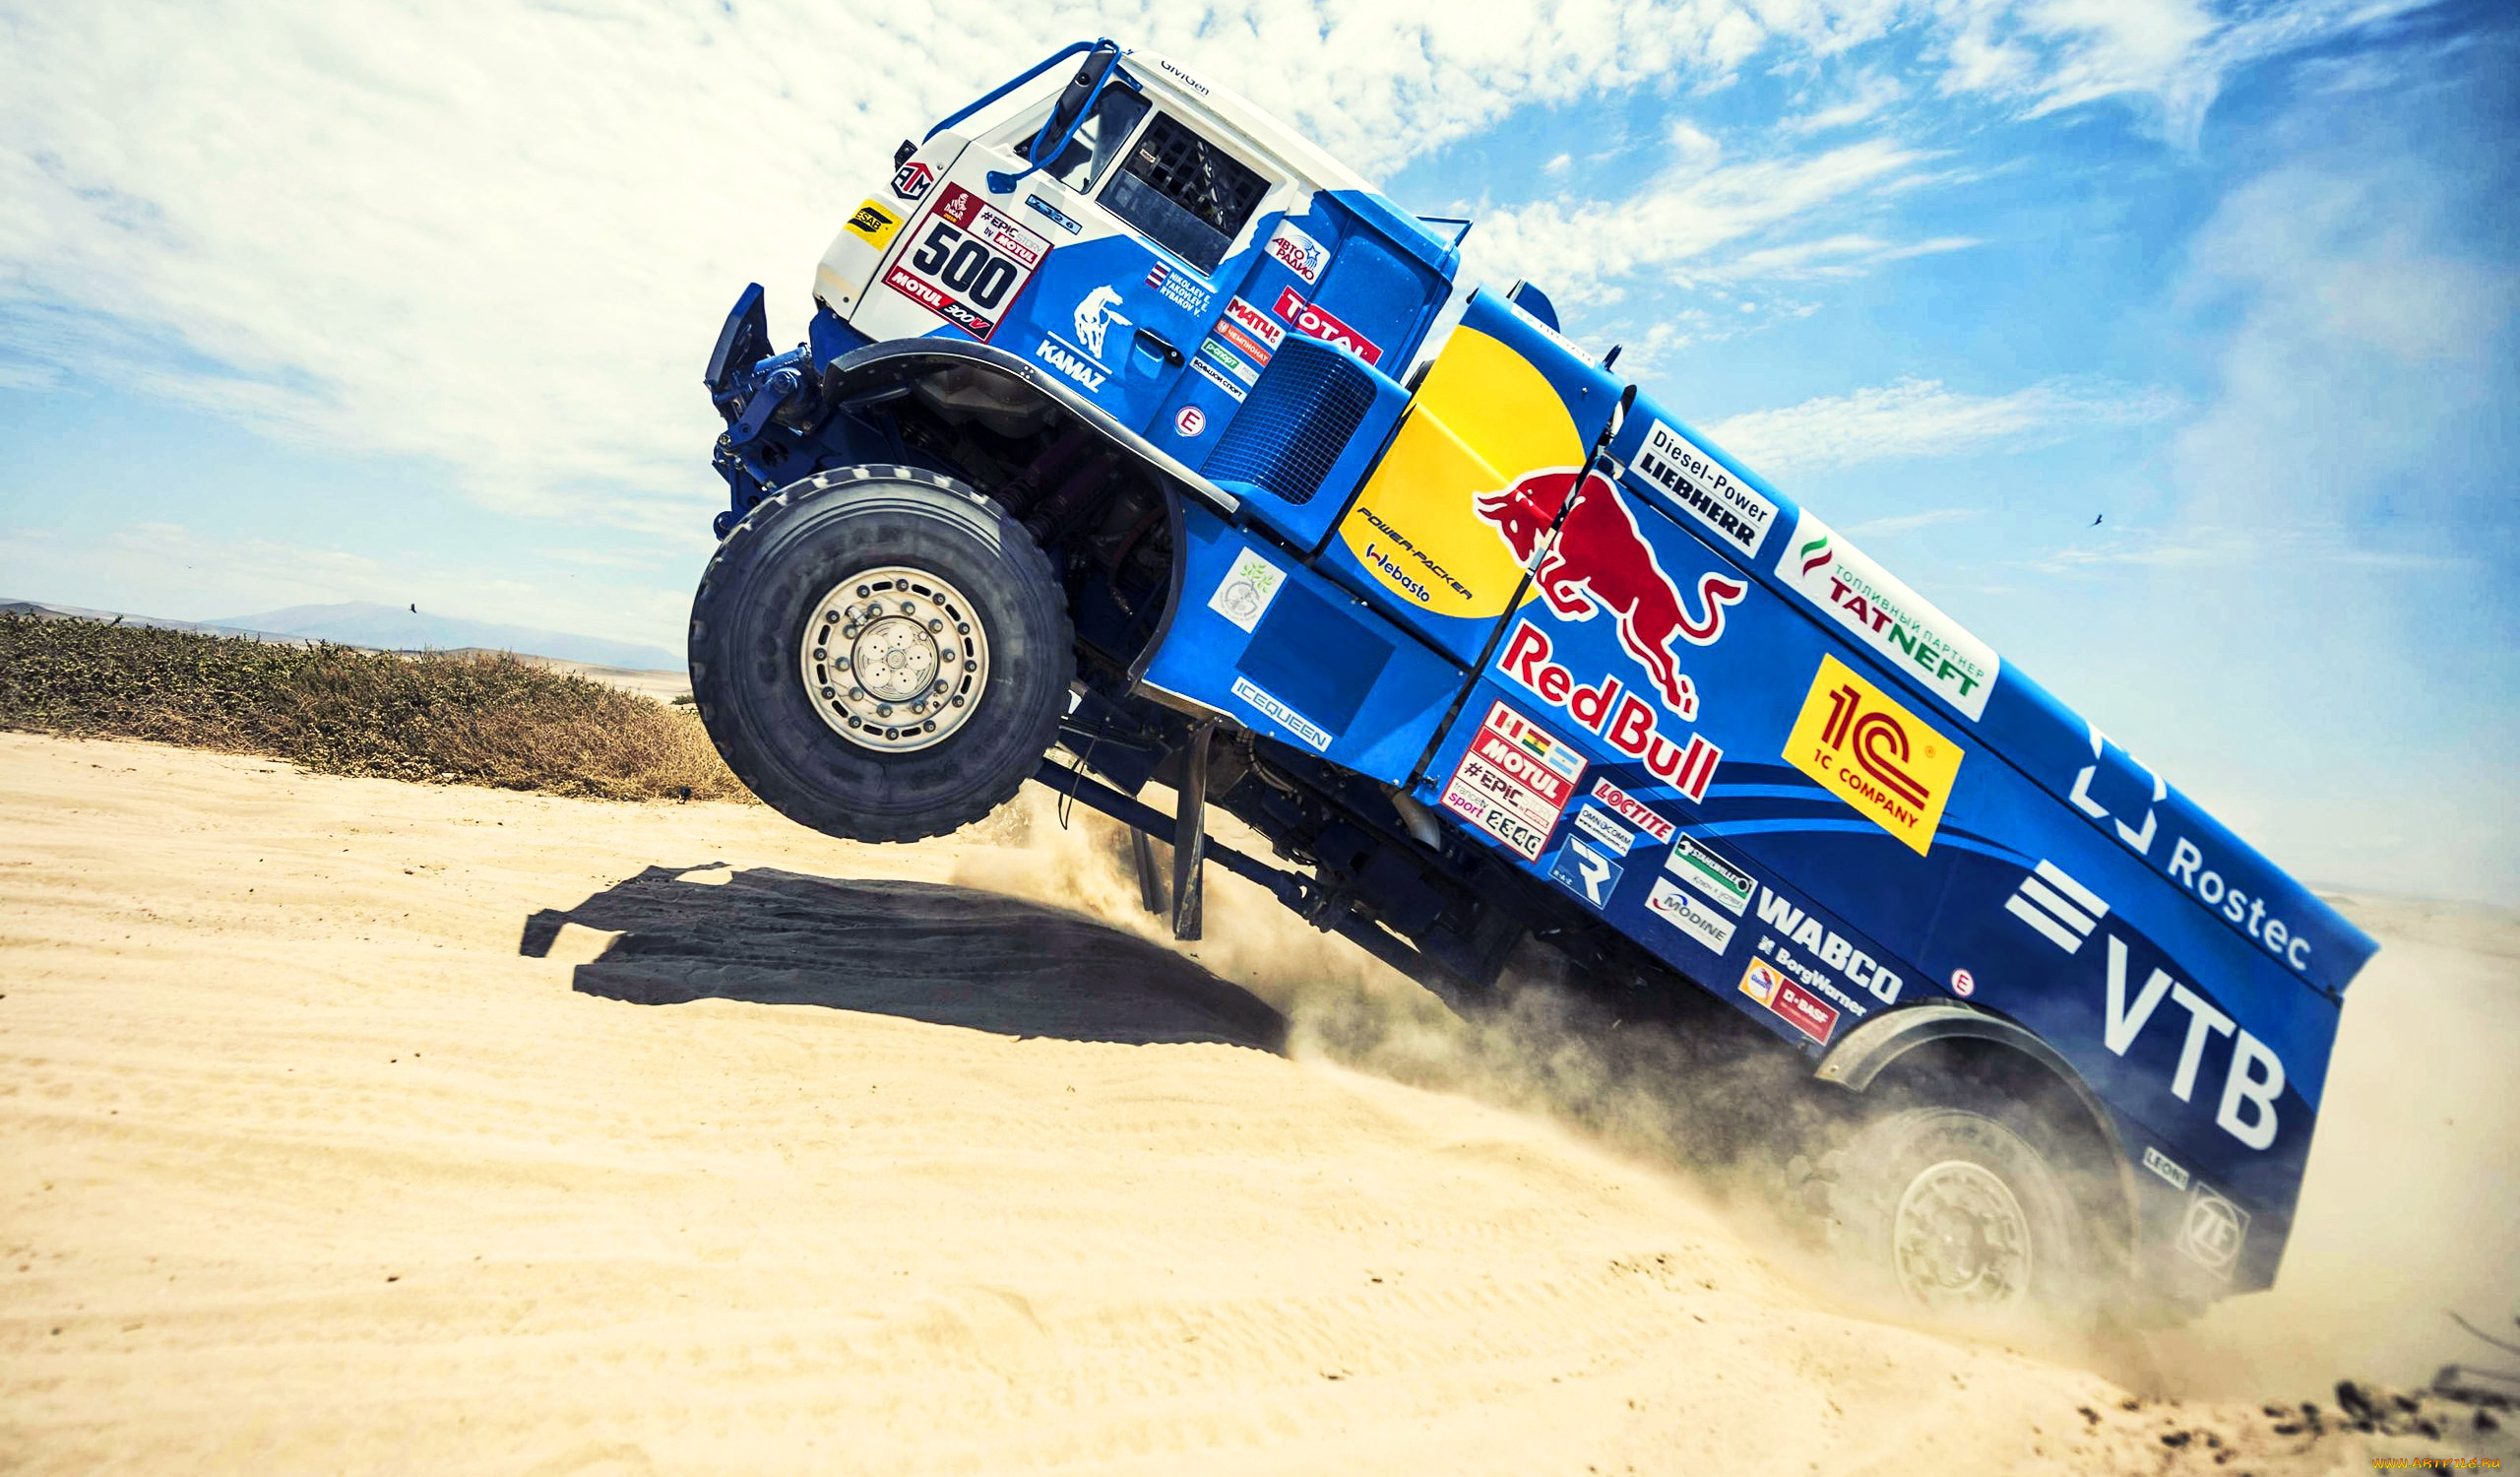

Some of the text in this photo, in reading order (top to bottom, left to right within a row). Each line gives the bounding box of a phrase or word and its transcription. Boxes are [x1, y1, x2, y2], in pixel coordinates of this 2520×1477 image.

[1161, 60, 1210, 96] GiviGen
[854, 210, 882, 230] ESAB
[995, 233, 1036, 263] MOTUL
[912, 220, 1018, 311] 500
[1271, 237, 1305, 261] АВТО
[1276, 248, 1315, 282] РАДИО
[891, 271, 991, 330] MOTUL 300V
[1159, 286, 1194, 312] RYBAKOV
[1165, 279, 1202, 307] YAKOVLEV
[1168, 271, 1211, 305] NIKOLAEV E.
[1227, 297, 1281, 344] МАТЧ!
[1228, 326, 1269, 362] ЧЕМПИОНАТ
[1036, 339, 1107, 394] KAMAZ
[1222, 379, 1243, 398] СПОРТ
[1639, 452, 1756, 547] LIEBHERR
[1652, 429, 1768, 524] Diesel-Power
[1355, 506, 1474, 602] POWER-PACKER
[1366, 543, 1431, 604] Webasto
[1828, 575, 1981, 698] TATNEFT
[1834, 563, 1984, 679] ТОПЛИВНЫЙ ПАРТНЕР
[1235, 681, 1328, 746] ICEQUEEN
[1499, 620, 1721, 801] Red Bull
[1480, 738, 1562, 799] MOTUL
[1448, 792, 1484, 818] sport
[1595, 783, 1672, 839] LOCTITE
[1839, 767, 1920, 829] COMPANY
[1664, 896, 1728, 942] MODINE
[2167, 835, 2312, 971] Rostec
[1756, 885, 1903, 1005] WABCO
[1775, 947, 1867, 1017] BorgWarner
[1797, 999, 1829, 1024] BASF
[2103, 933, 2286, 1151] VTB
